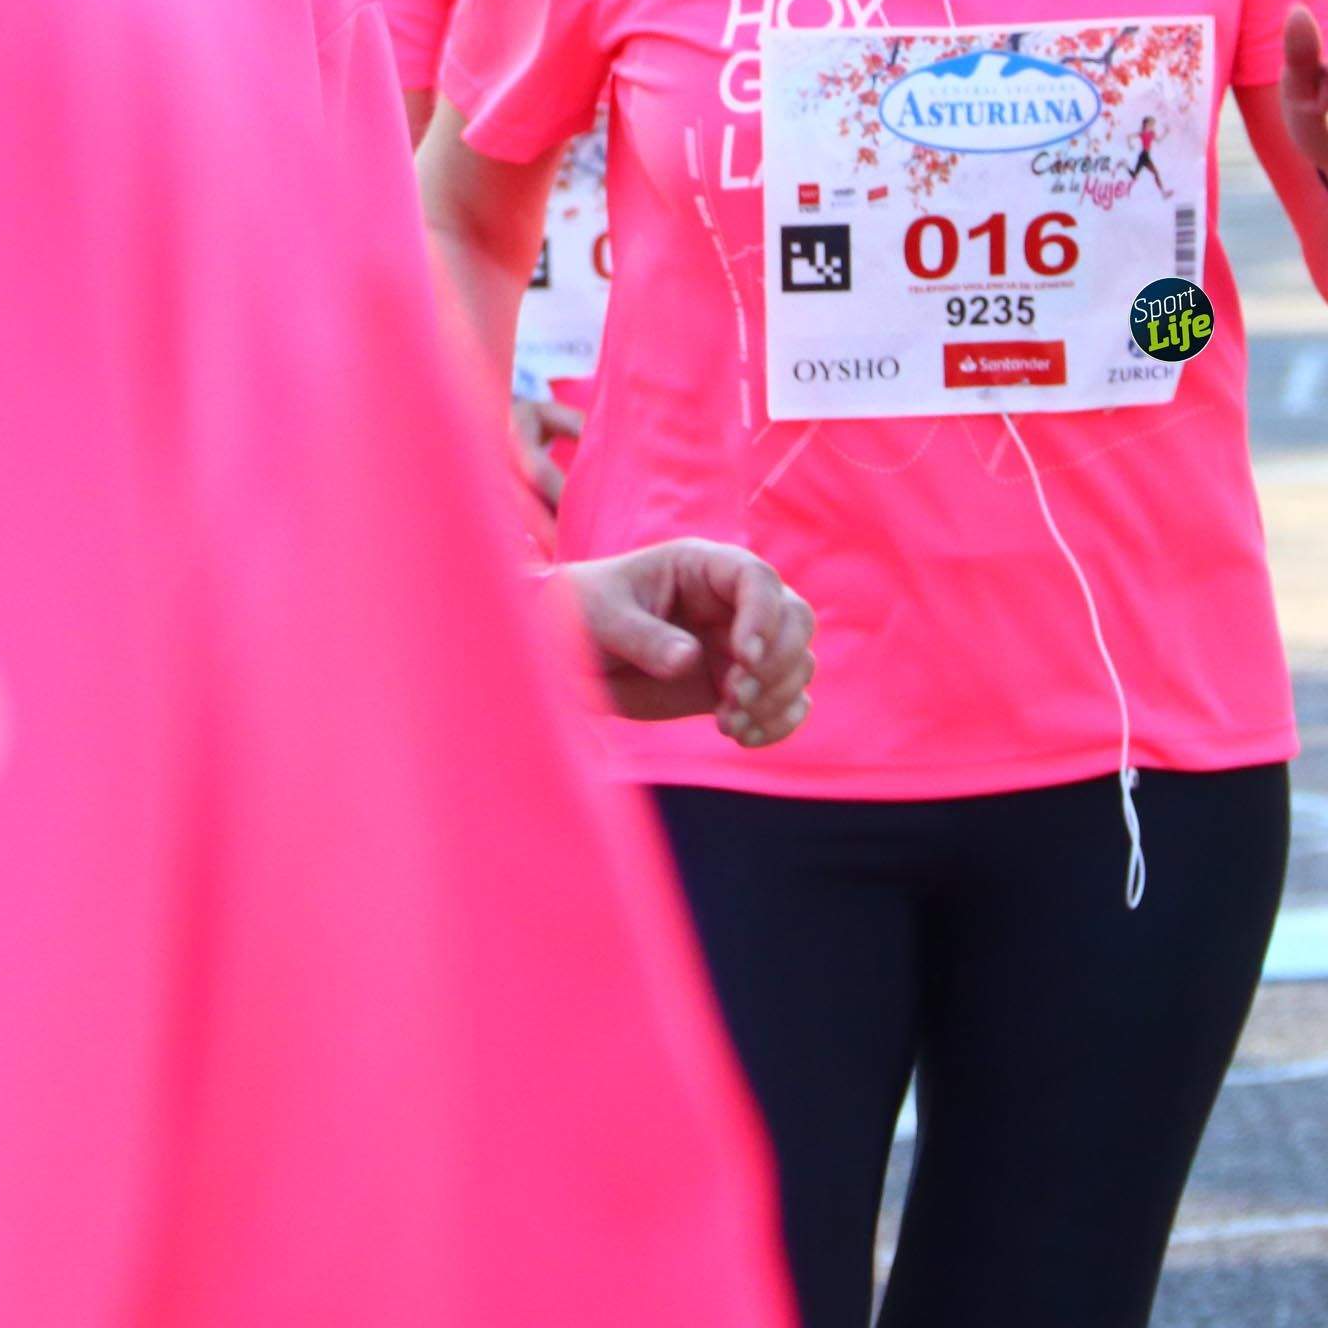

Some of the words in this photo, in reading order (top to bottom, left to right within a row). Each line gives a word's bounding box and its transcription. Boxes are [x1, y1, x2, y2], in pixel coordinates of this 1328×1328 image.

[896, 88, 1084, 128] ASTURIANA
[719, 123, 765, 190] L
[1079, 175, 1135, 211] Mujer
[903, 212, 1080, 280] 016
[945, 295, 1036, 327] 9235
[793, 356, 901, 384] OYSHO
[979, 356, 1052, 373] Santander
[1107, 365, 1175, 385] ZURICH
